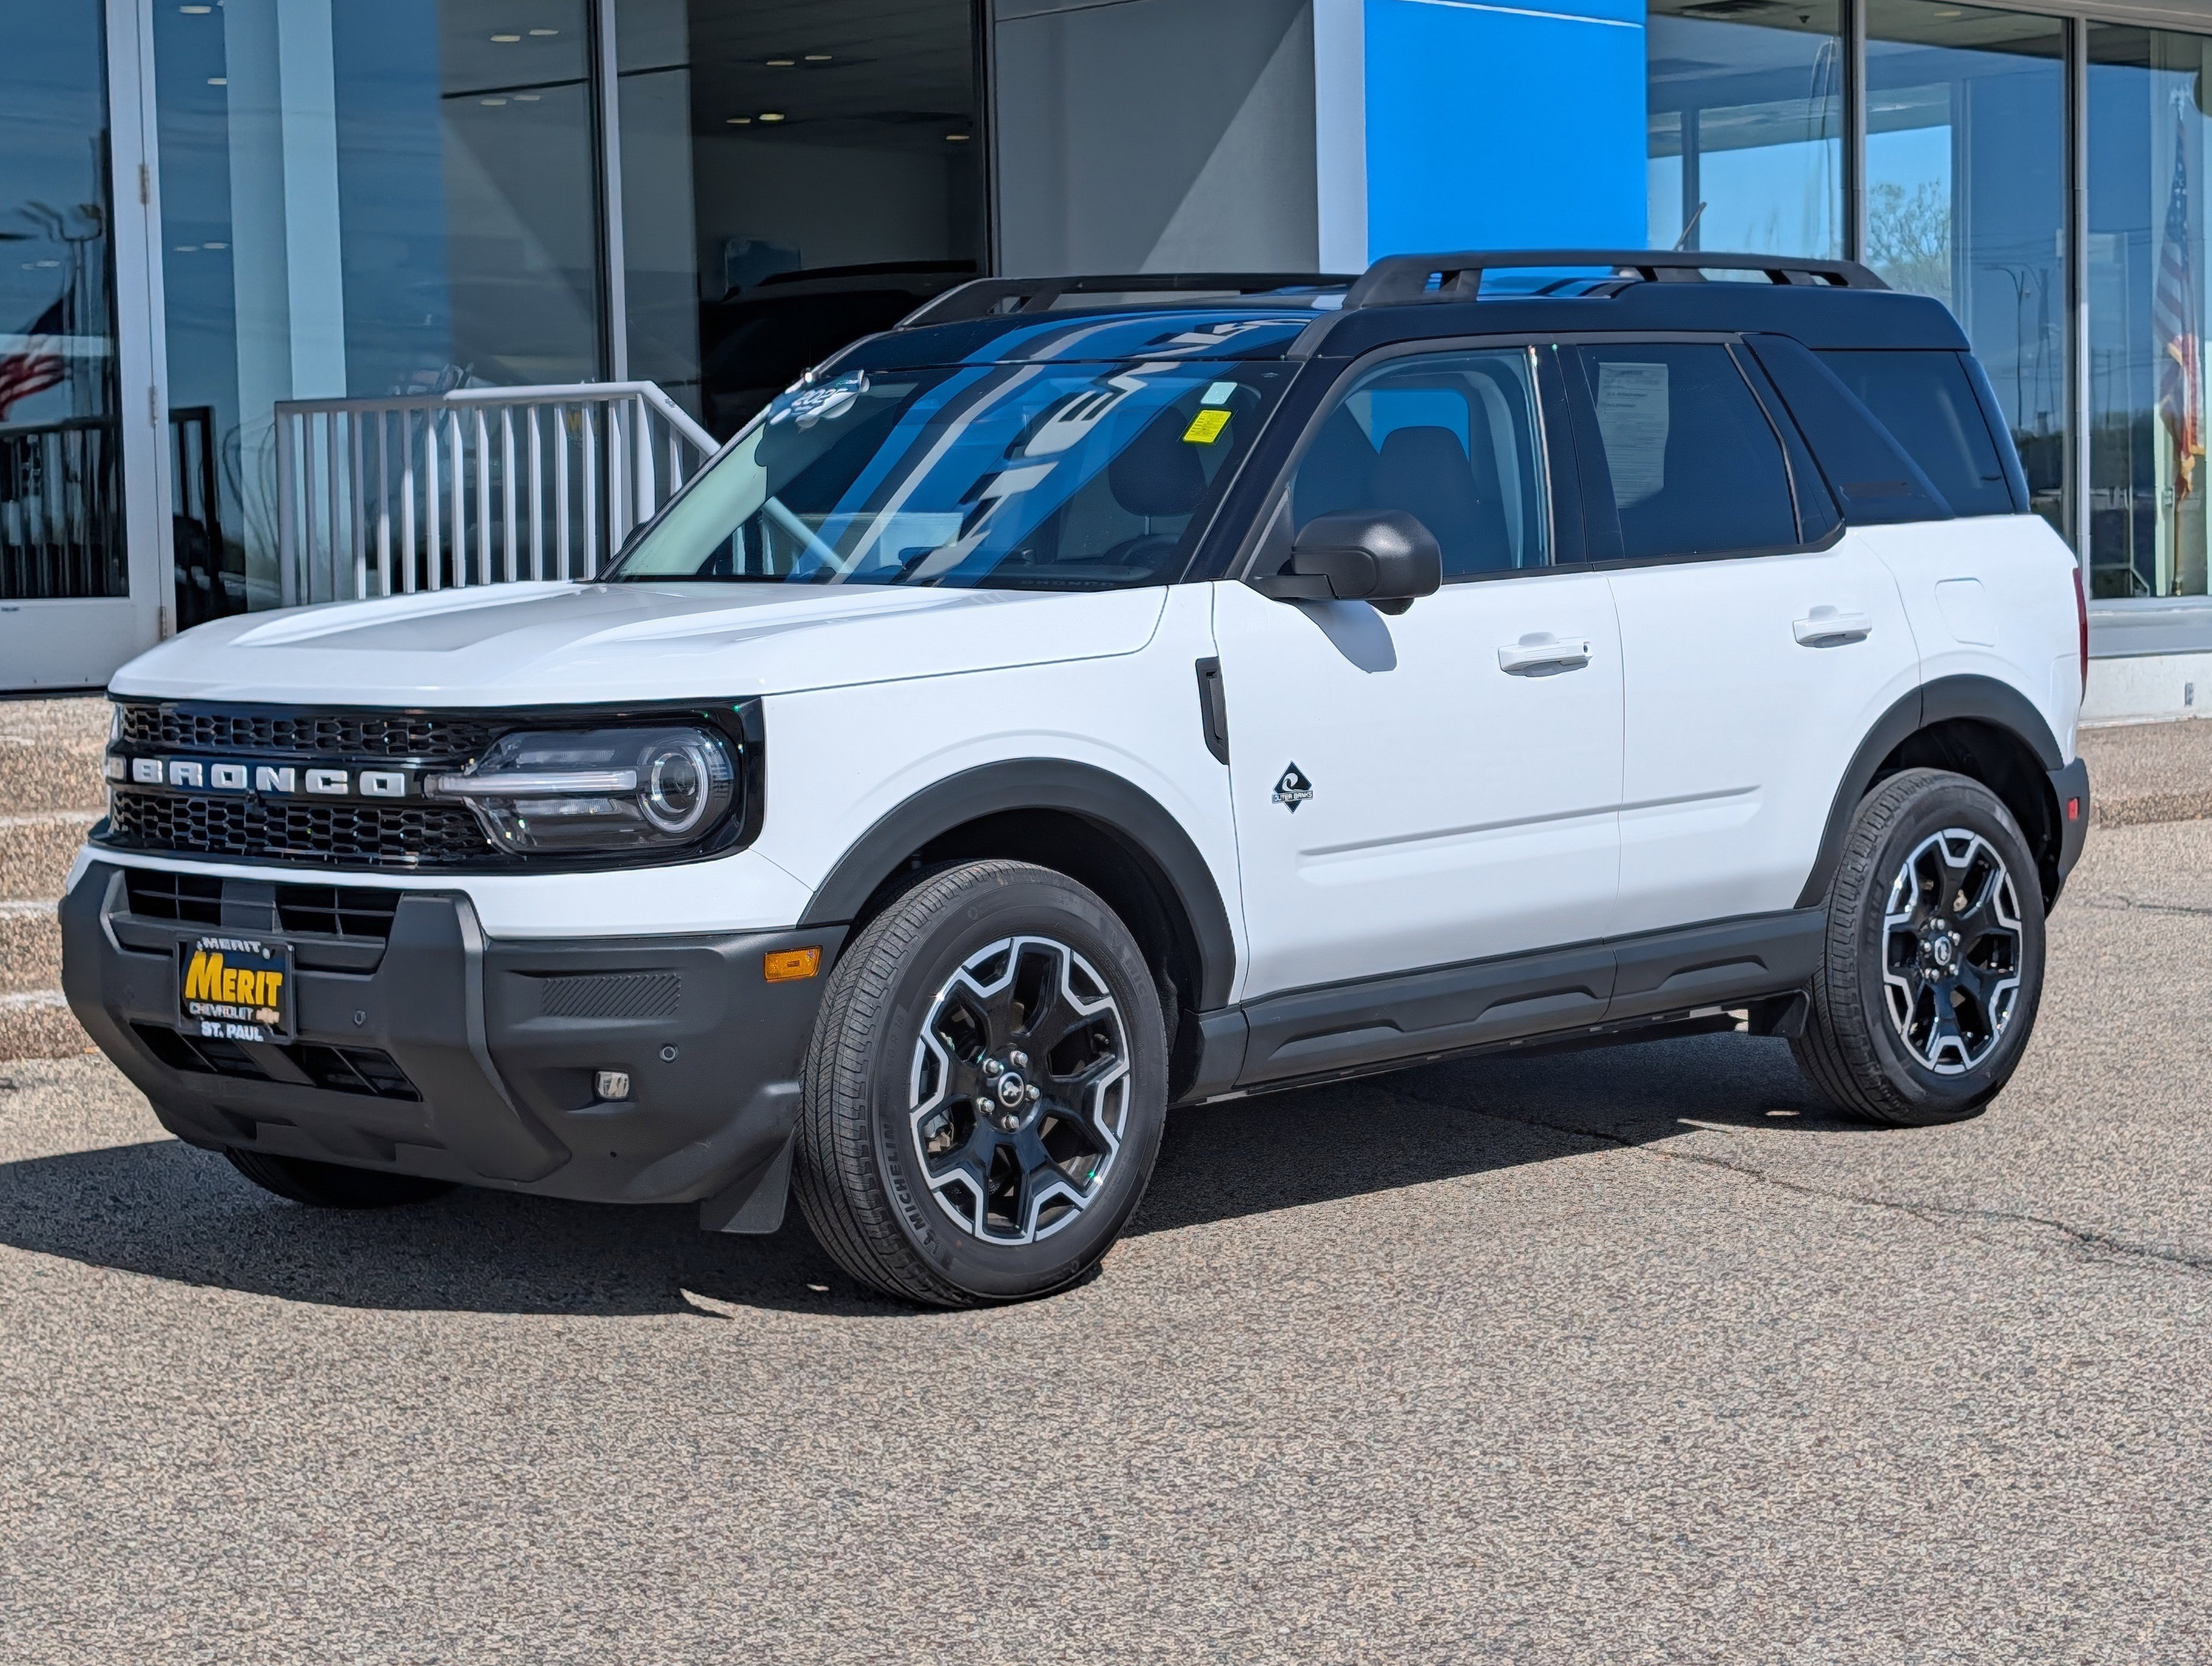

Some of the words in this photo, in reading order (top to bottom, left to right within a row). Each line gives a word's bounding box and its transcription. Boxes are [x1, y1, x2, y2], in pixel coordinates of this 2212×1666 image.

[132, 758, 406, 797] BRONCO
[202, 937, 261, 953] MERIT
[201, 1021, 224, 1038] ST.
[226, 1023, 264, 1042] PAUL
[884, 1123, 925, 1231] MICHELIN
